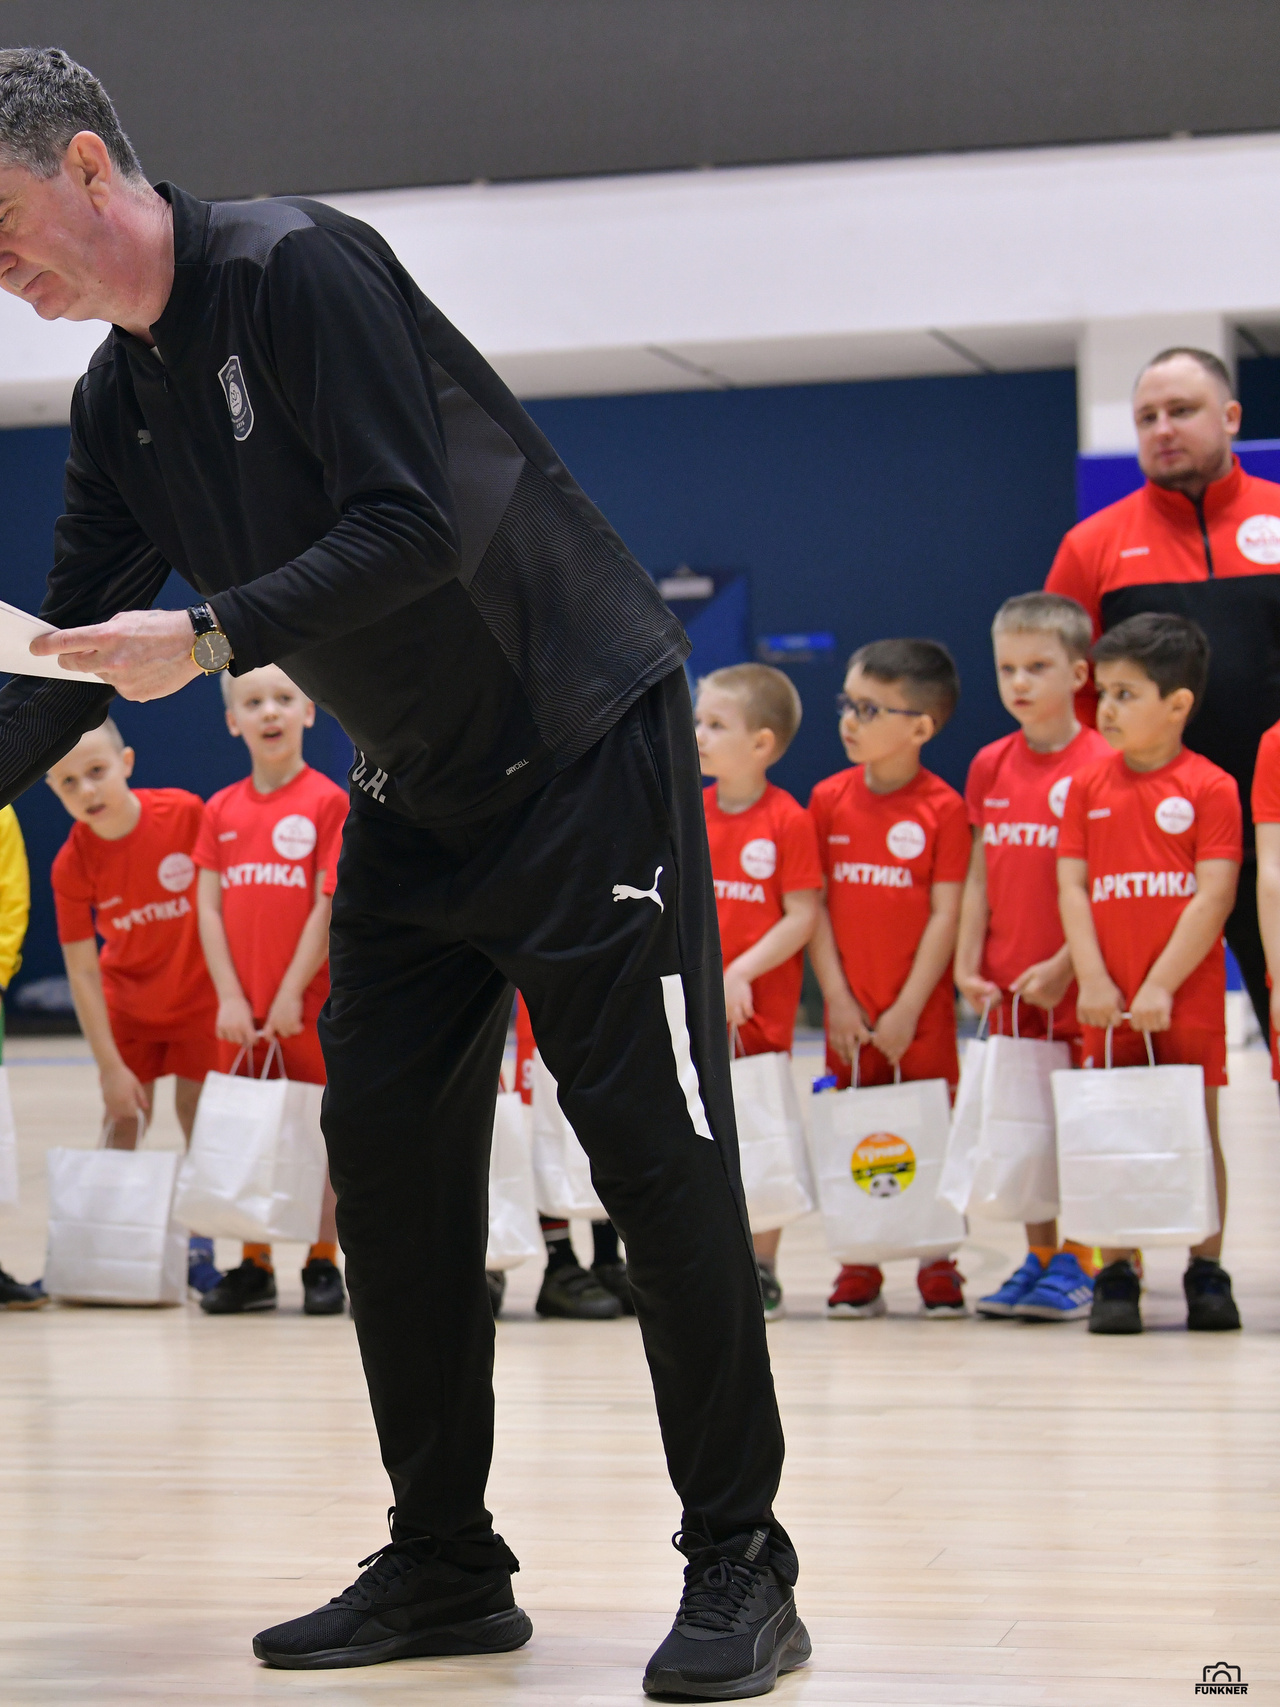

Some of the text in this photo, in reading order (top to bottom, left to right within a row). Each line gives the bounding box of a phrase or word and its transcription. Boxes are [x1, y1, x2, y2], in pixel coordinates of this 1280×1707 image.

[505, 758, 530, 776] DRYCELL
[713, 879, 766, 904] ТИКА
[1092, 871, 1197, 903] АРКТИКА
[744, 1529, 766, 1562] PUMA
